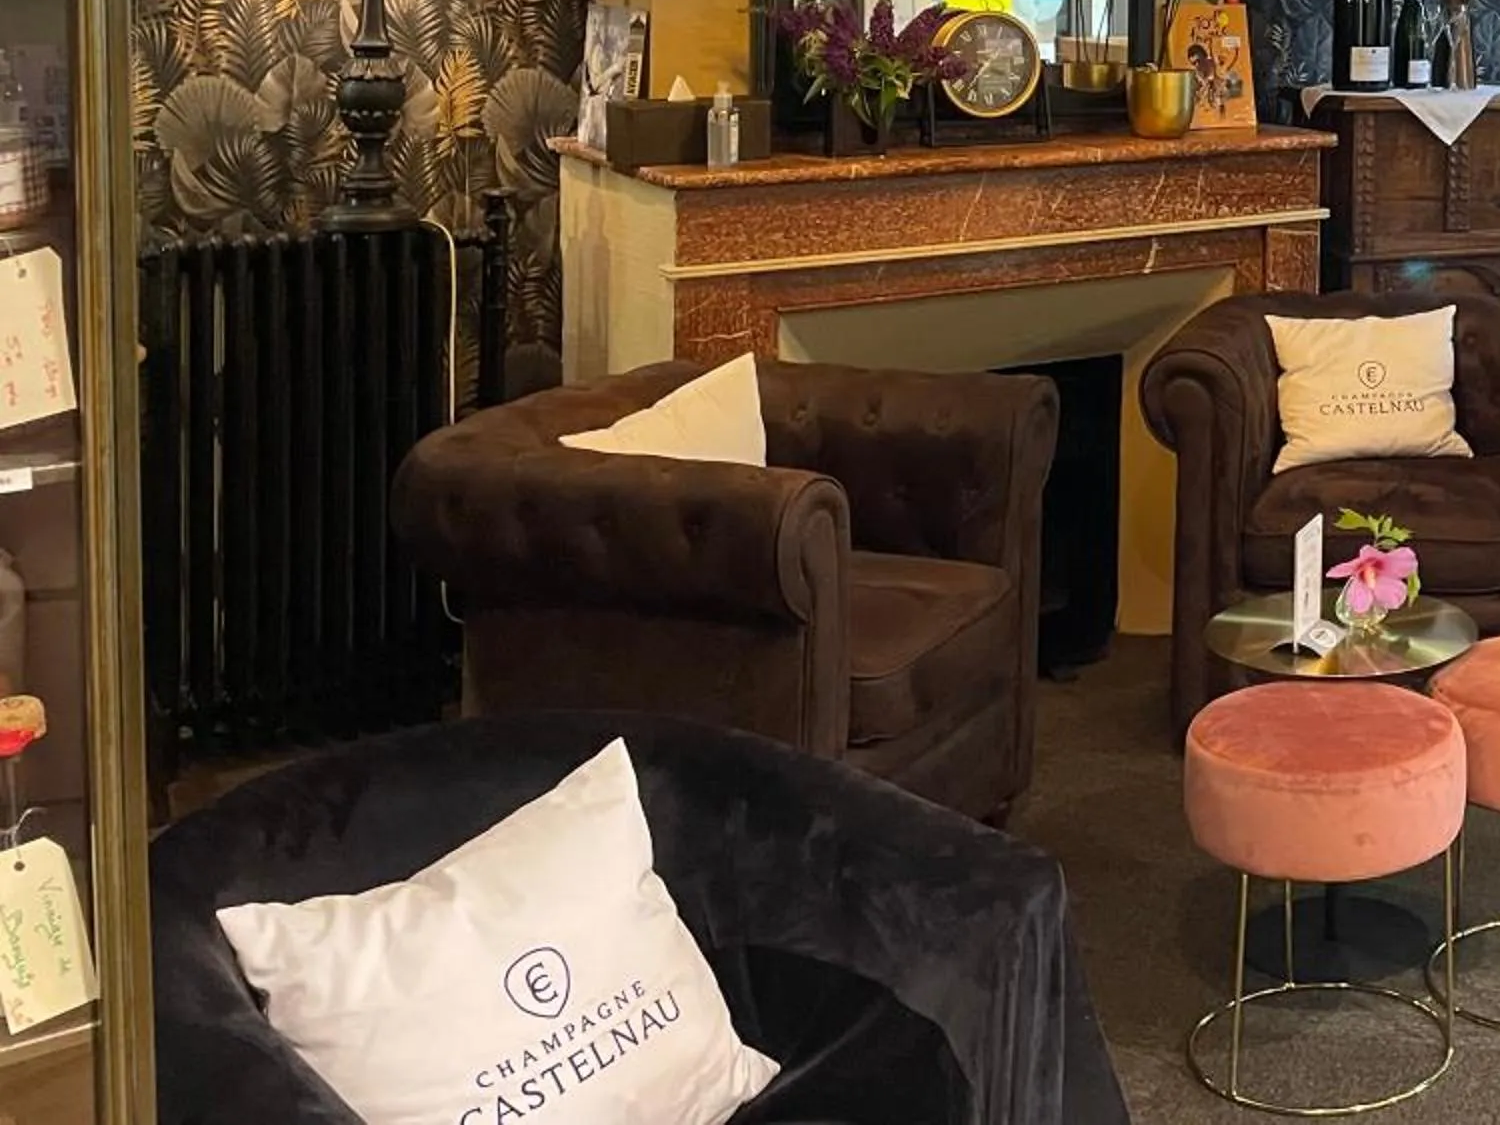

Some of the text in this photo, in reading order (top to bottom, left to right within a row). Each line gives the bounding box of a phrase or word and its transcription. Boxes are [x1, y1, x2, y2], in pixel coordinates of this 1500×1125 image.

[1320, 399, 1425, 415] CASTELNAU
[459, 990, 681, 1125] CASTELNAU
[475, 980, 646, 1088] CHAMPAGNE
